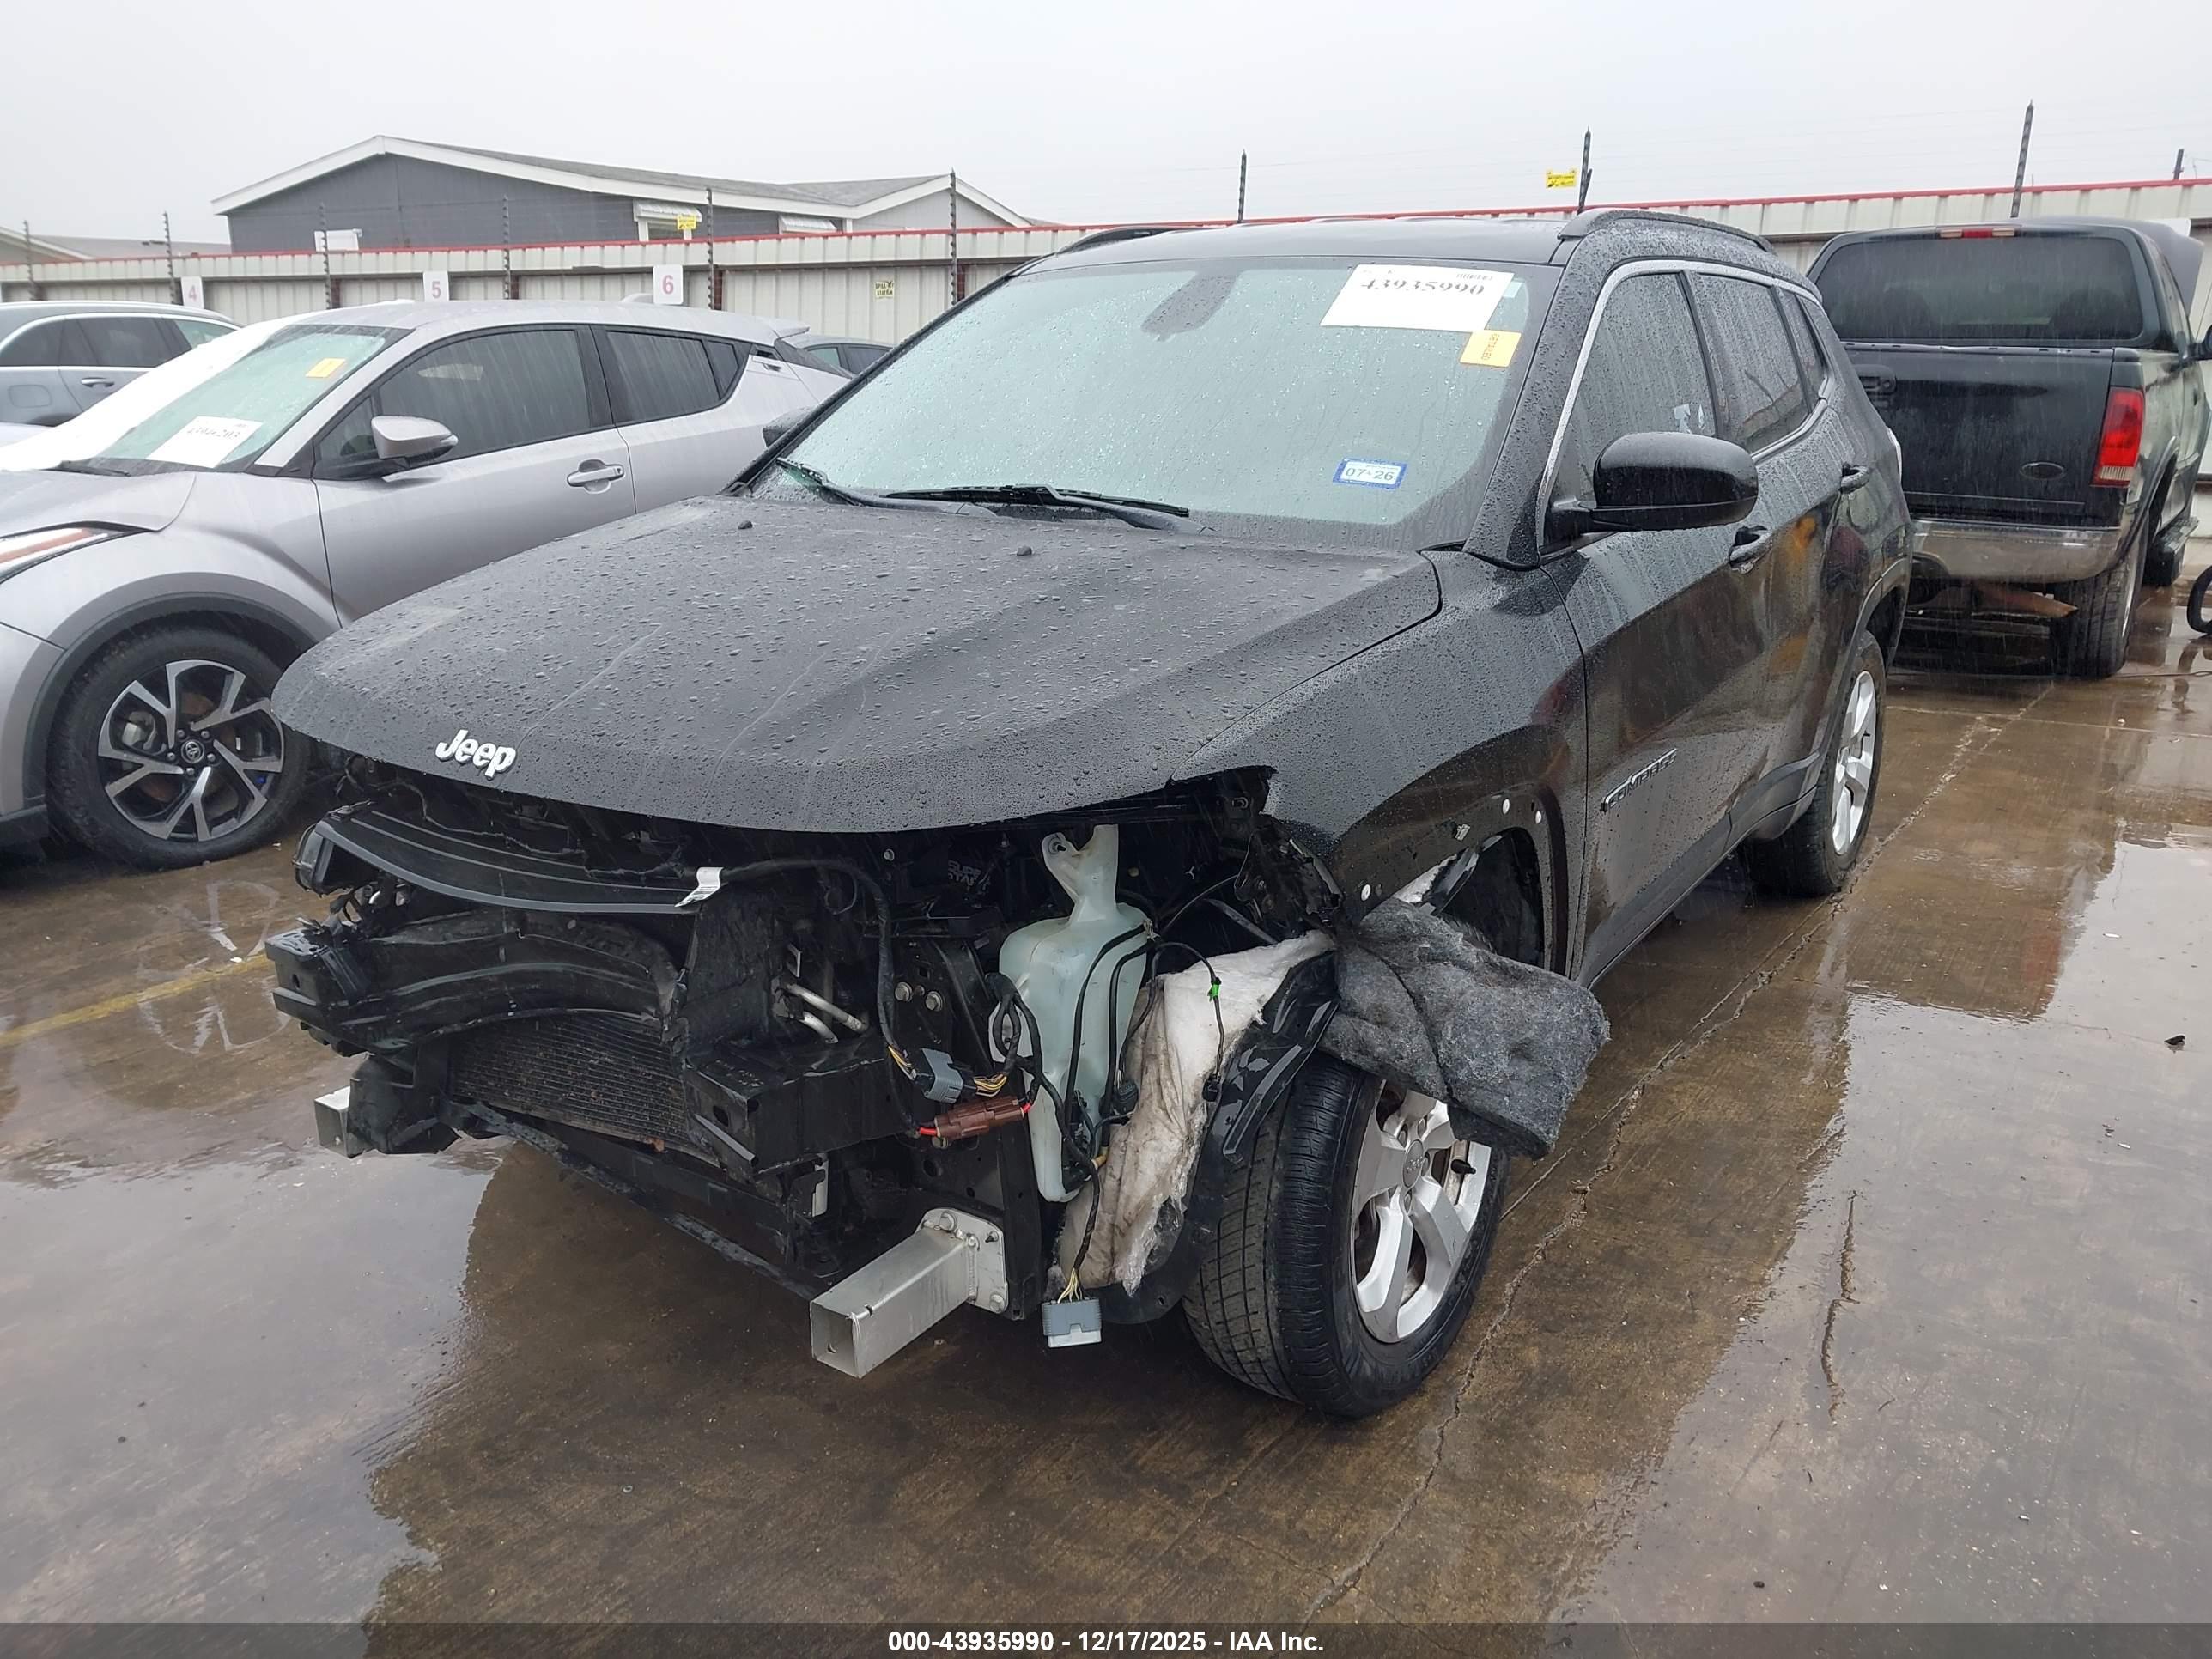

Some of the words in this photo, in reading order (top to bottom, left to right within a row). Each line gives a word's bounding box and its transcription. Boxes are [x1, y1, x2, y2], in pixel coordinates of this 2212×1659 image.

[189, 285, 198, 301] 4
[432, 281, 441, 299] 5
[663, 275, 674, 295] 6
[1362, 278, 1485, 295] 43935990
[1346, 467, 1366, 477] 07
[1373, 470, 1395, 481] 26
[435, 729, 517, 781] Jeep
